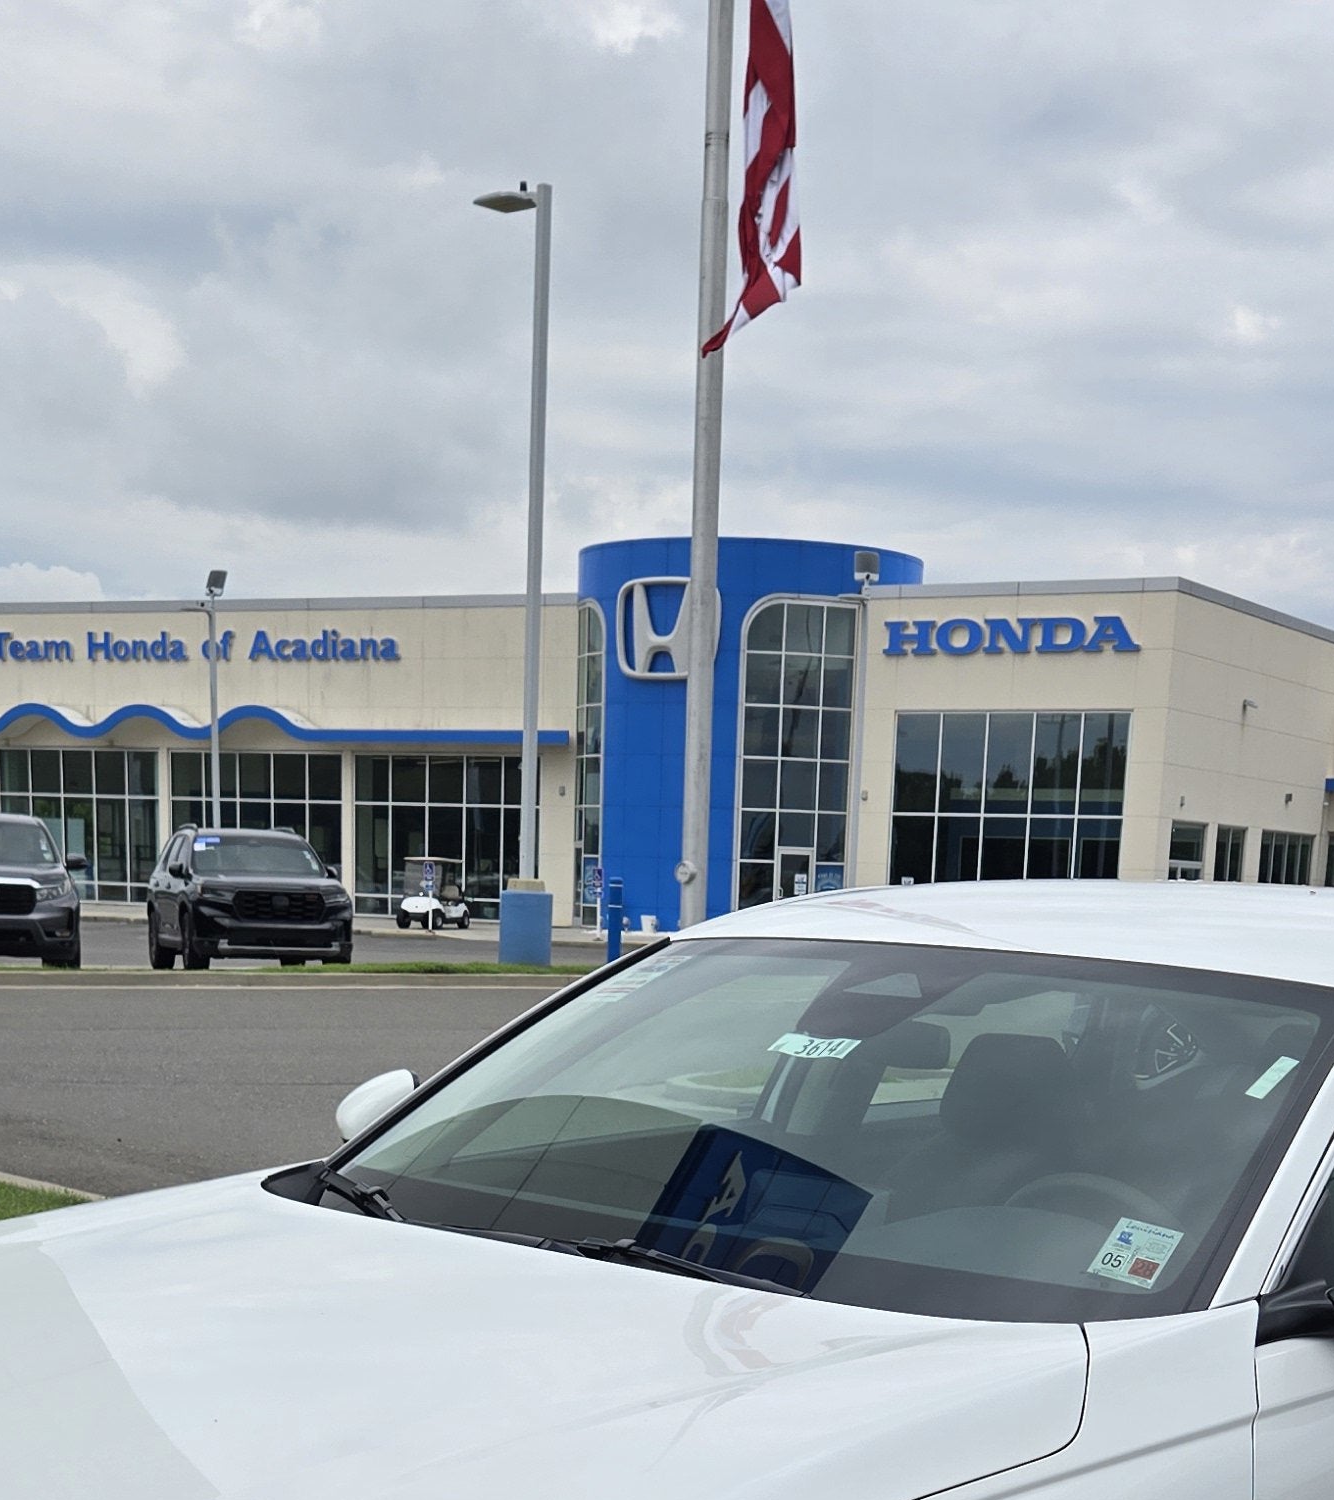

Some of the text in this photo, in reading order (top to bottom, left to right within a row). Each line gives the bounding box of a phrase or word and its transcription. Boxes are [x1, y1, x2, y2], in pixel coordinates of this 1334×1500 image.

[86, 630, 188, 662] Honda
[201, 629, 235, 661] of
[248, 628, 401, 662] Acadiana
[882, 615, 1142, 656] HONDA
[794, 1040, 845, 1056] 3614
[1101, 1252, 1125, 1268] 05
